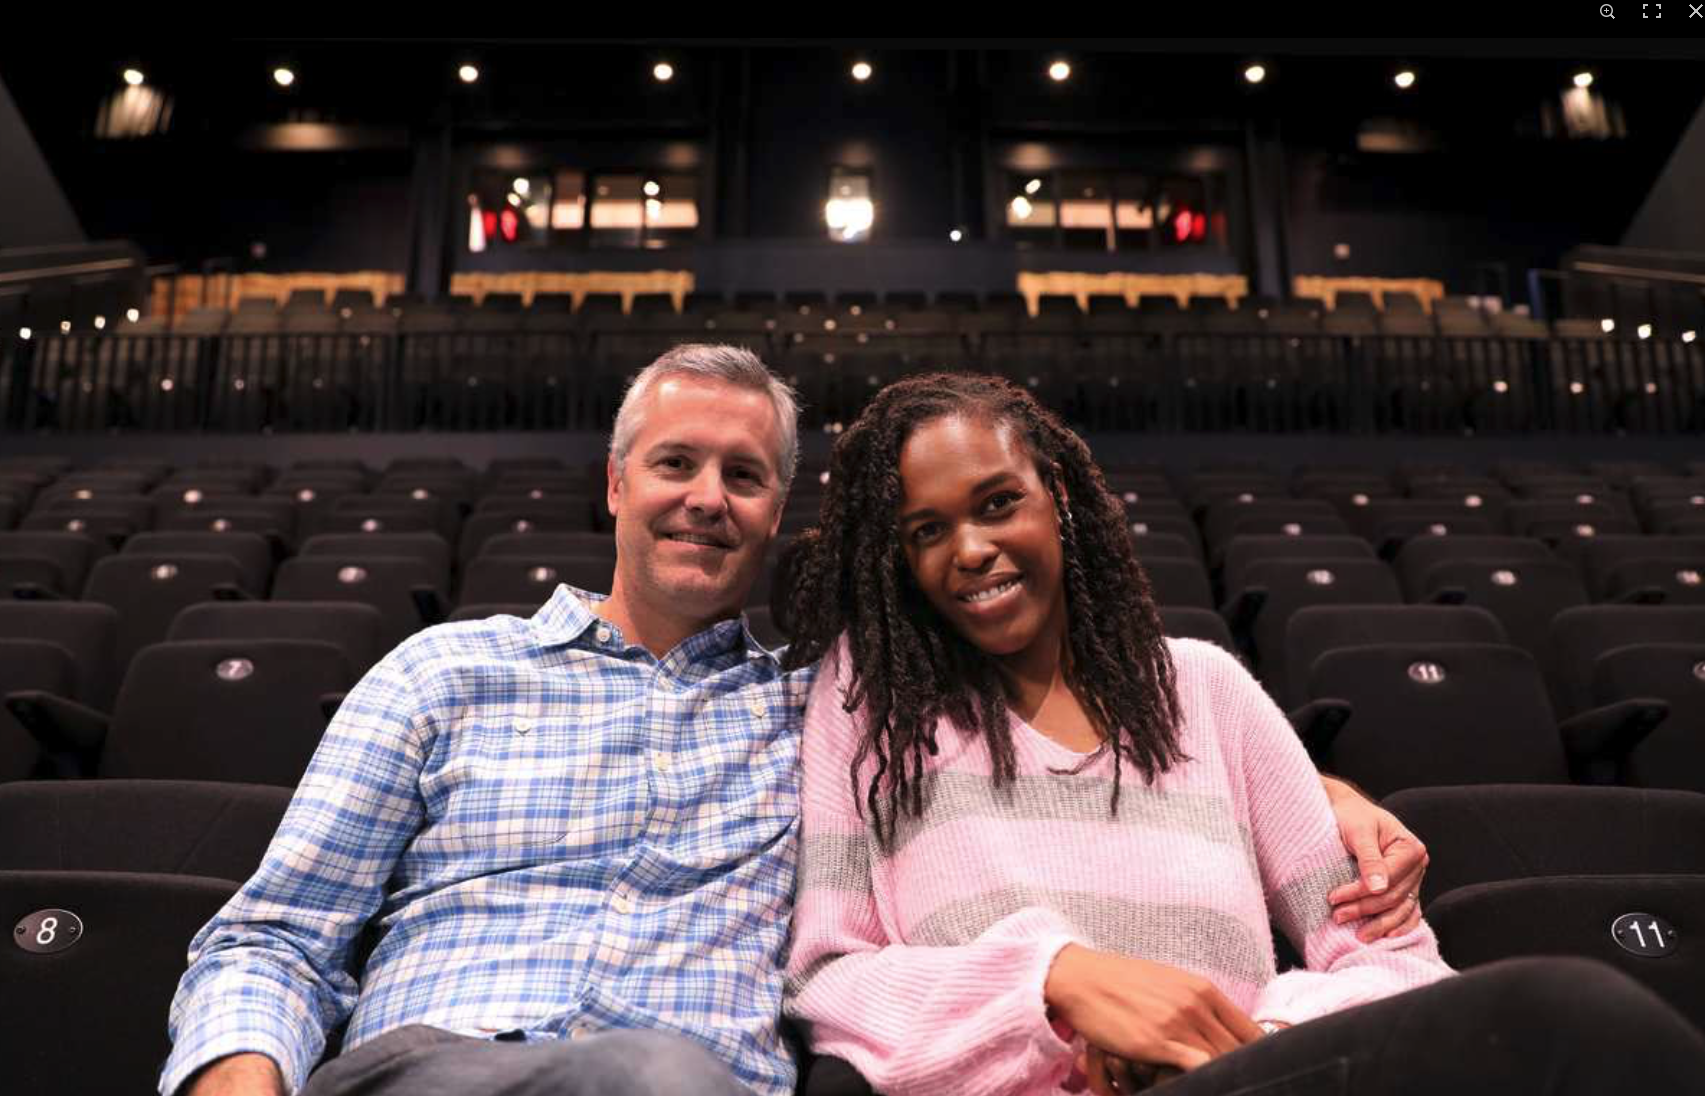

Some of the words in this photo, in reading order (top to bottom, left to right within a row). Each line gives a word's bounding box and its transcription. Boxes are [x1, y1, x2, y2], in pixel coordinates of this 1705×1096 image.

[1418, 664, 1439, 680] 11
[36, 917, 58, 945] 8
[1629, 921, 1665, 948] 11
